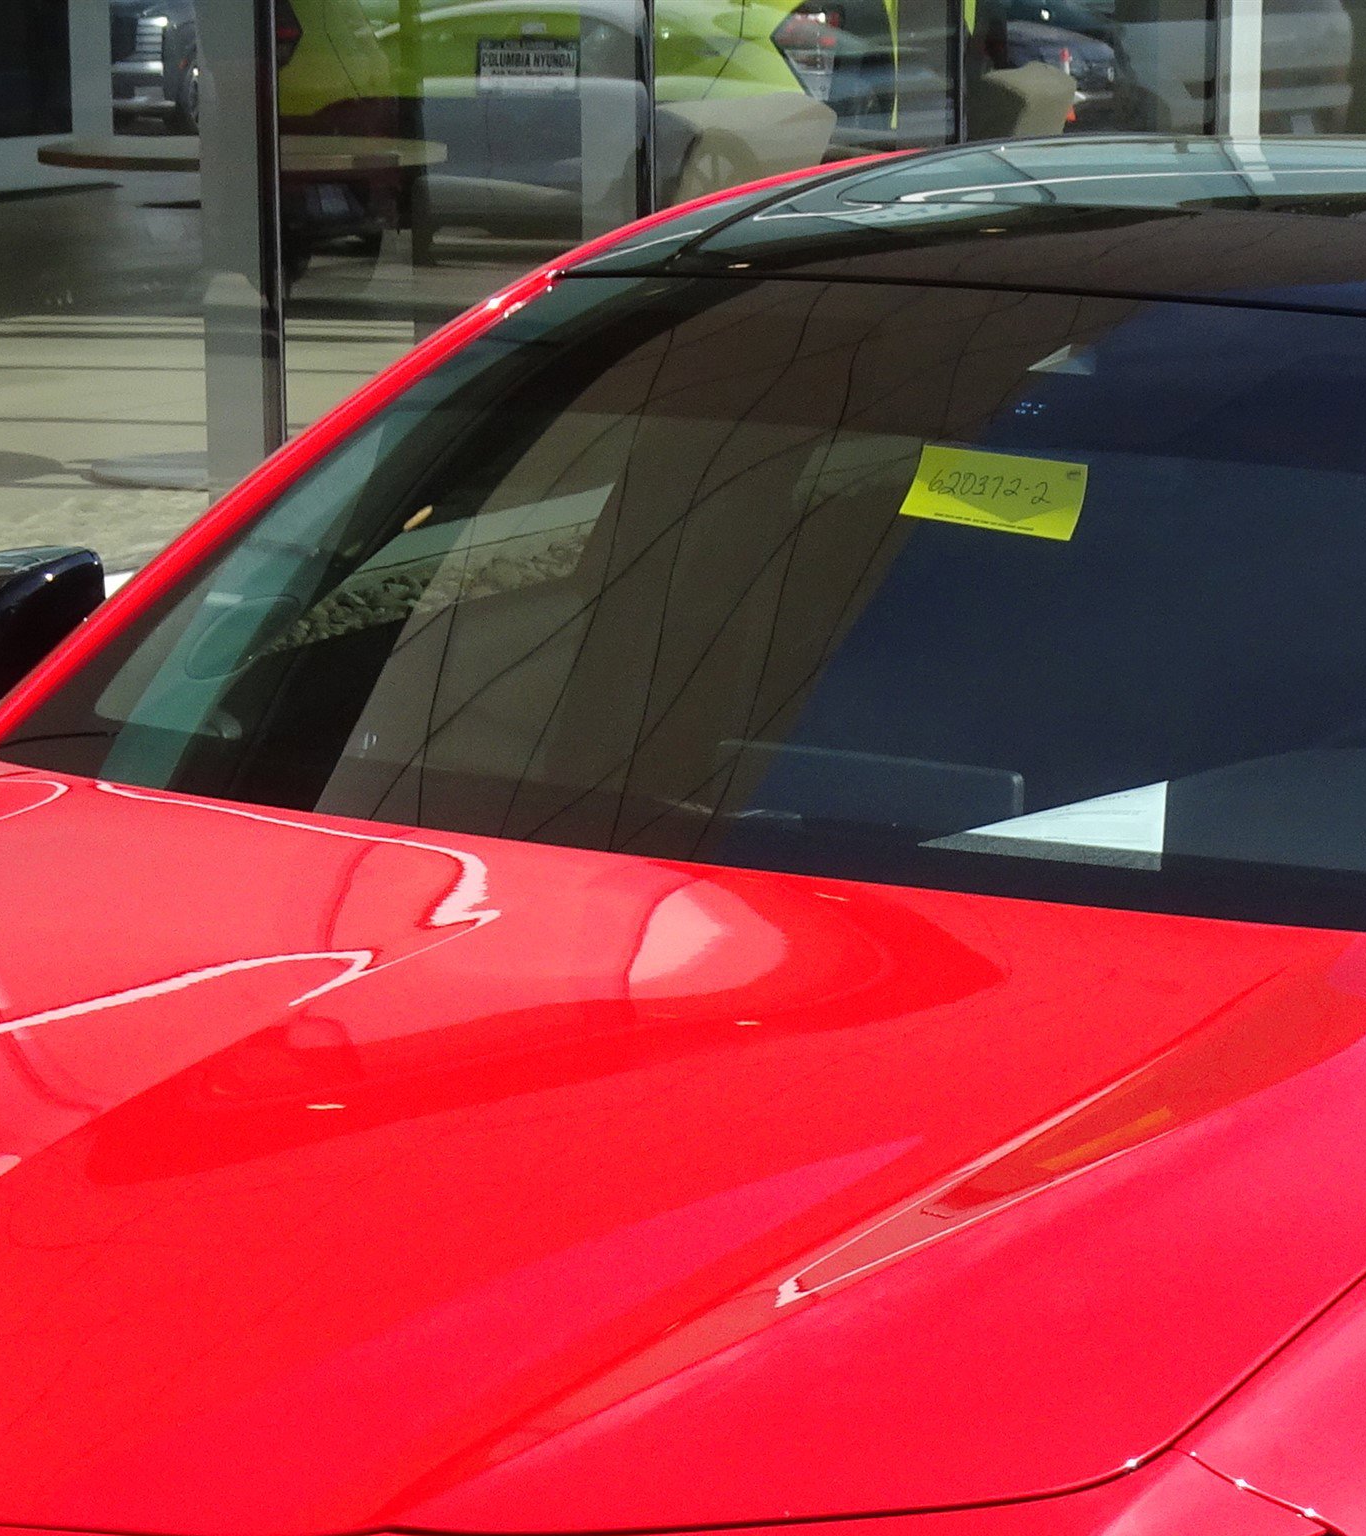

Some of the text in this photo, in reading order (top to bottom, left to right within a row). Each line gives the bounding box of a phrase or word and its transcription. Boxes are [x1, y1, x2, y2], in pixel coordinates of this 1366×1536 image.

[482, 52, 576, 68] COLUMBIA HYUNDAI
[927, 468, 1050, 505] 620372-2
